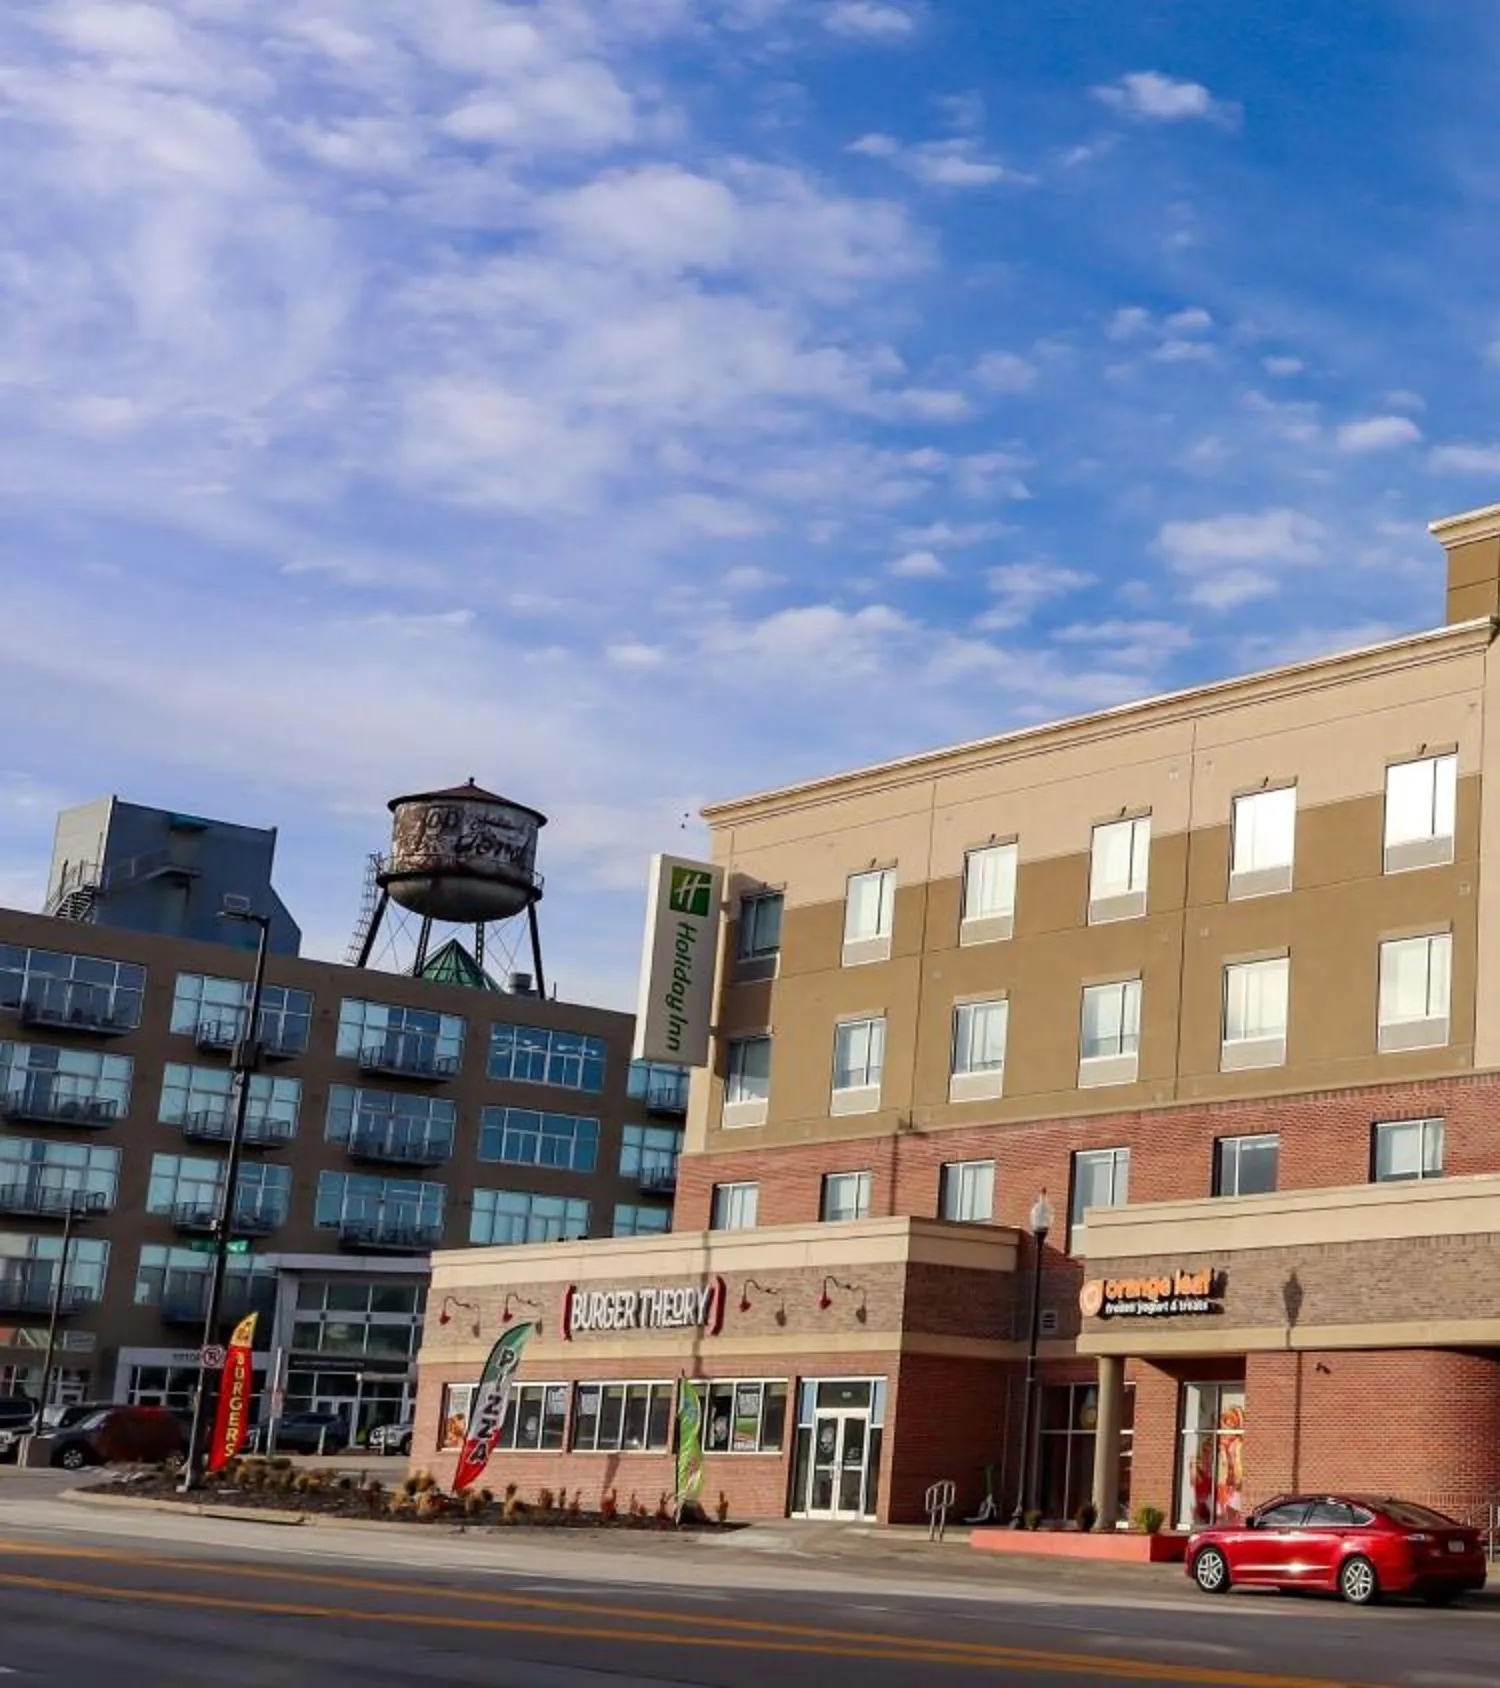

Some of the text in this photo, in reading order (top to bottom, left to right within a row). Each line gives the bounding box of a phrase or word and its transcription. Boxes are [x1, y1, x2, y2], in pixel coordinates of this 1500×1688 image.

[665, 921, 698, 1052] Holiday Inn
[571, 1286, 711, 1330] BURGER THEORY
[1105, 1302, 1136, 1314] frozen
[1137, 1301, 1168, 1315] yogurt
[1179, 1299, 1209, 1311] treats
[1106, 1266, 1211, 1302] orange leaf
[224, 1351, 245, 1457] BURGERS
[467, 1345, 517, 1465] PIZZA
